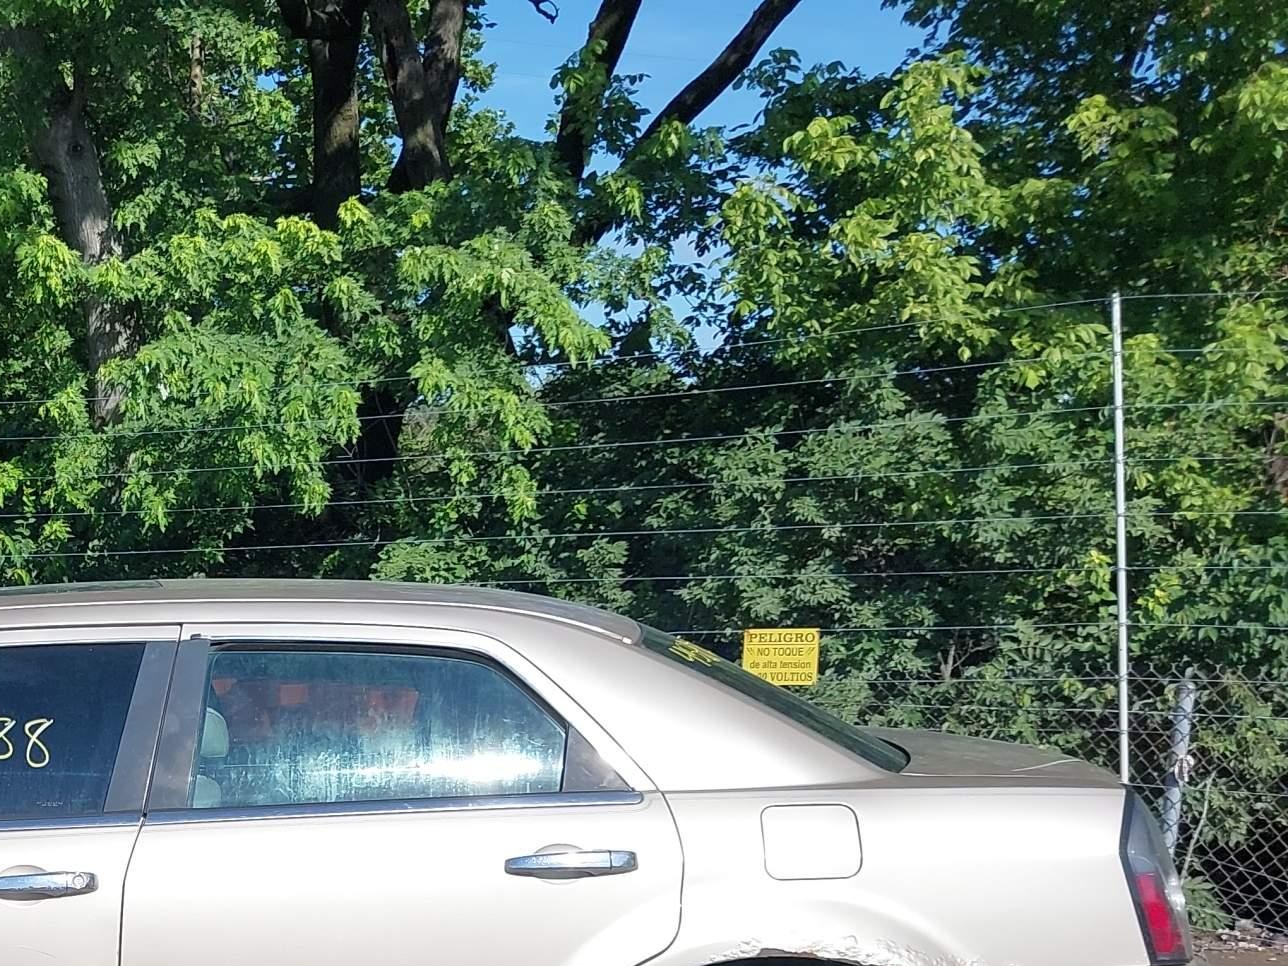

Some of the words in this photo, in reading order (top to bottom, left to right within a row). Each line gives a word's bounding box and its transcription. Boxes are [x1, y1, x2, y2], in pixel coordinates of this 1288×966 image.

[748, 632, 816, 643] PELIGRO
[757, 647, 770, 657] NO
[772, 647, 804, 657] TOQUE
[749, 660, 761, 669] de
[762, 660, 777, 669] alta
[770, 672, 814, 682] VOLTIOS
